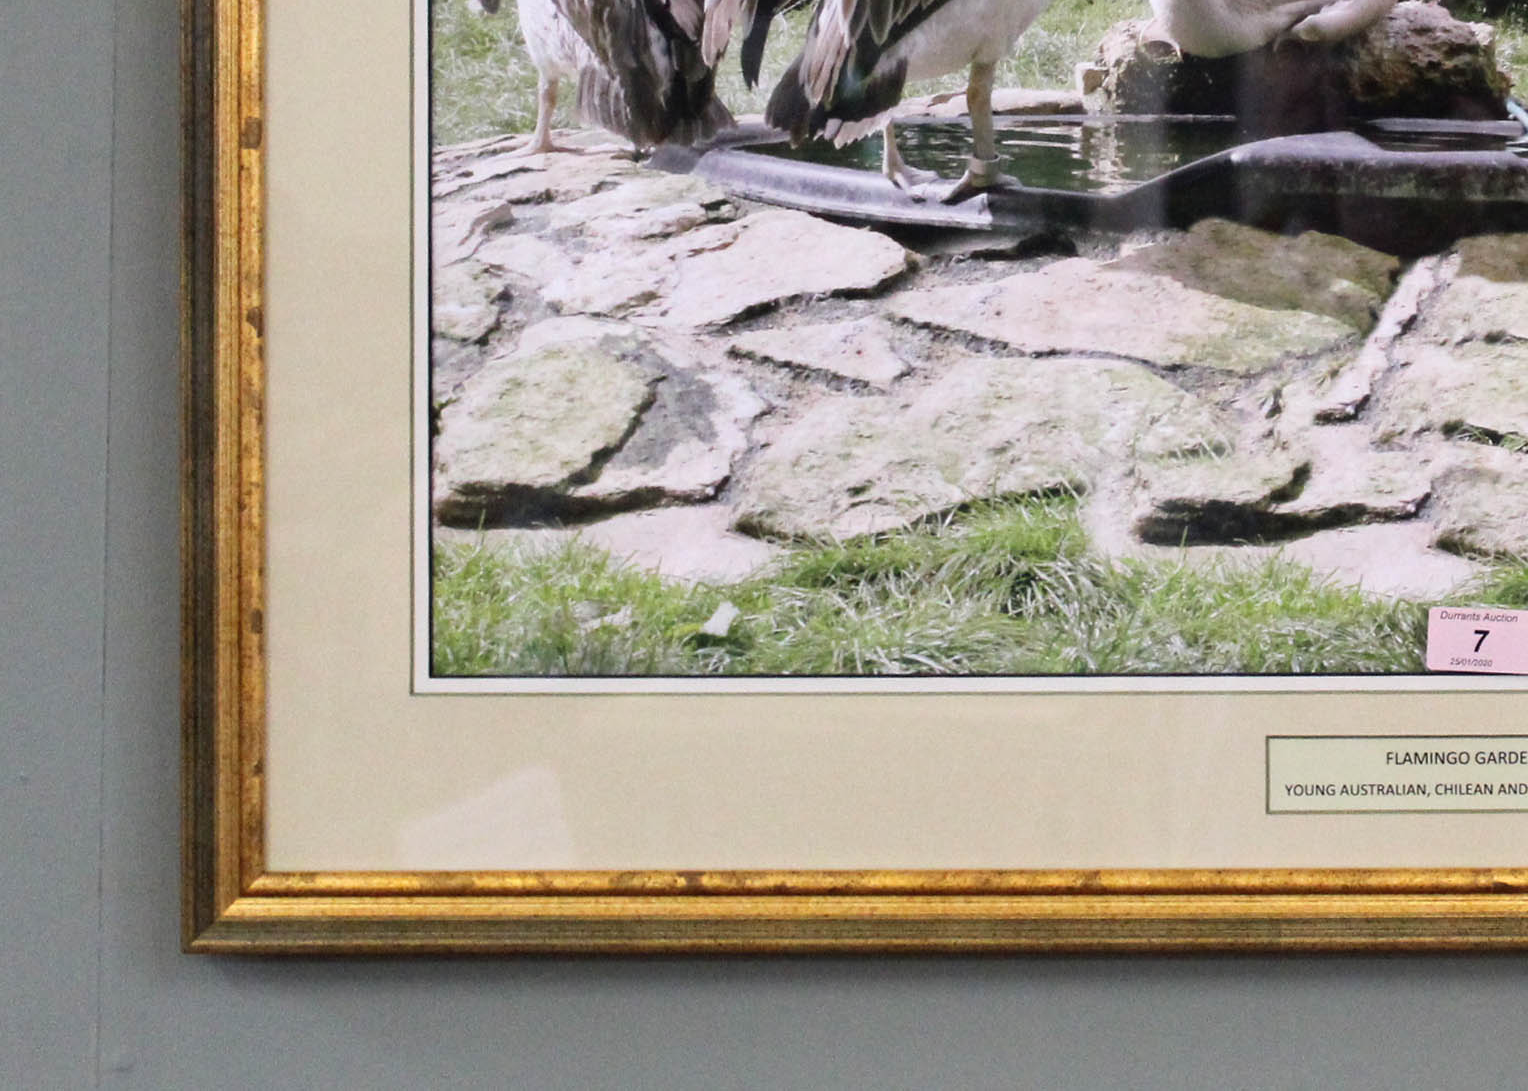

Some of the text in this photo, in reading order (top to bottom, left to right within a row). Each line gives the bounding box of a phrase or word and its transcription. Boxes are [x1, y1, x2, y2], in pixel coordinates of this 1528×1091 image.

[1440, 610, 1519, 623] Durrants Auction
[1473, 629, 1490, 653] 7
[1386, 751, 1471, 766] FLAMINGO
[1285, 783, 1336, 797] YOUNG
[1339, 783, 1431, 797] AUSTRALIAN,
[1434, 783, 1494, 796] CHILEAN
[1498, 783, 1528, 796] AND
